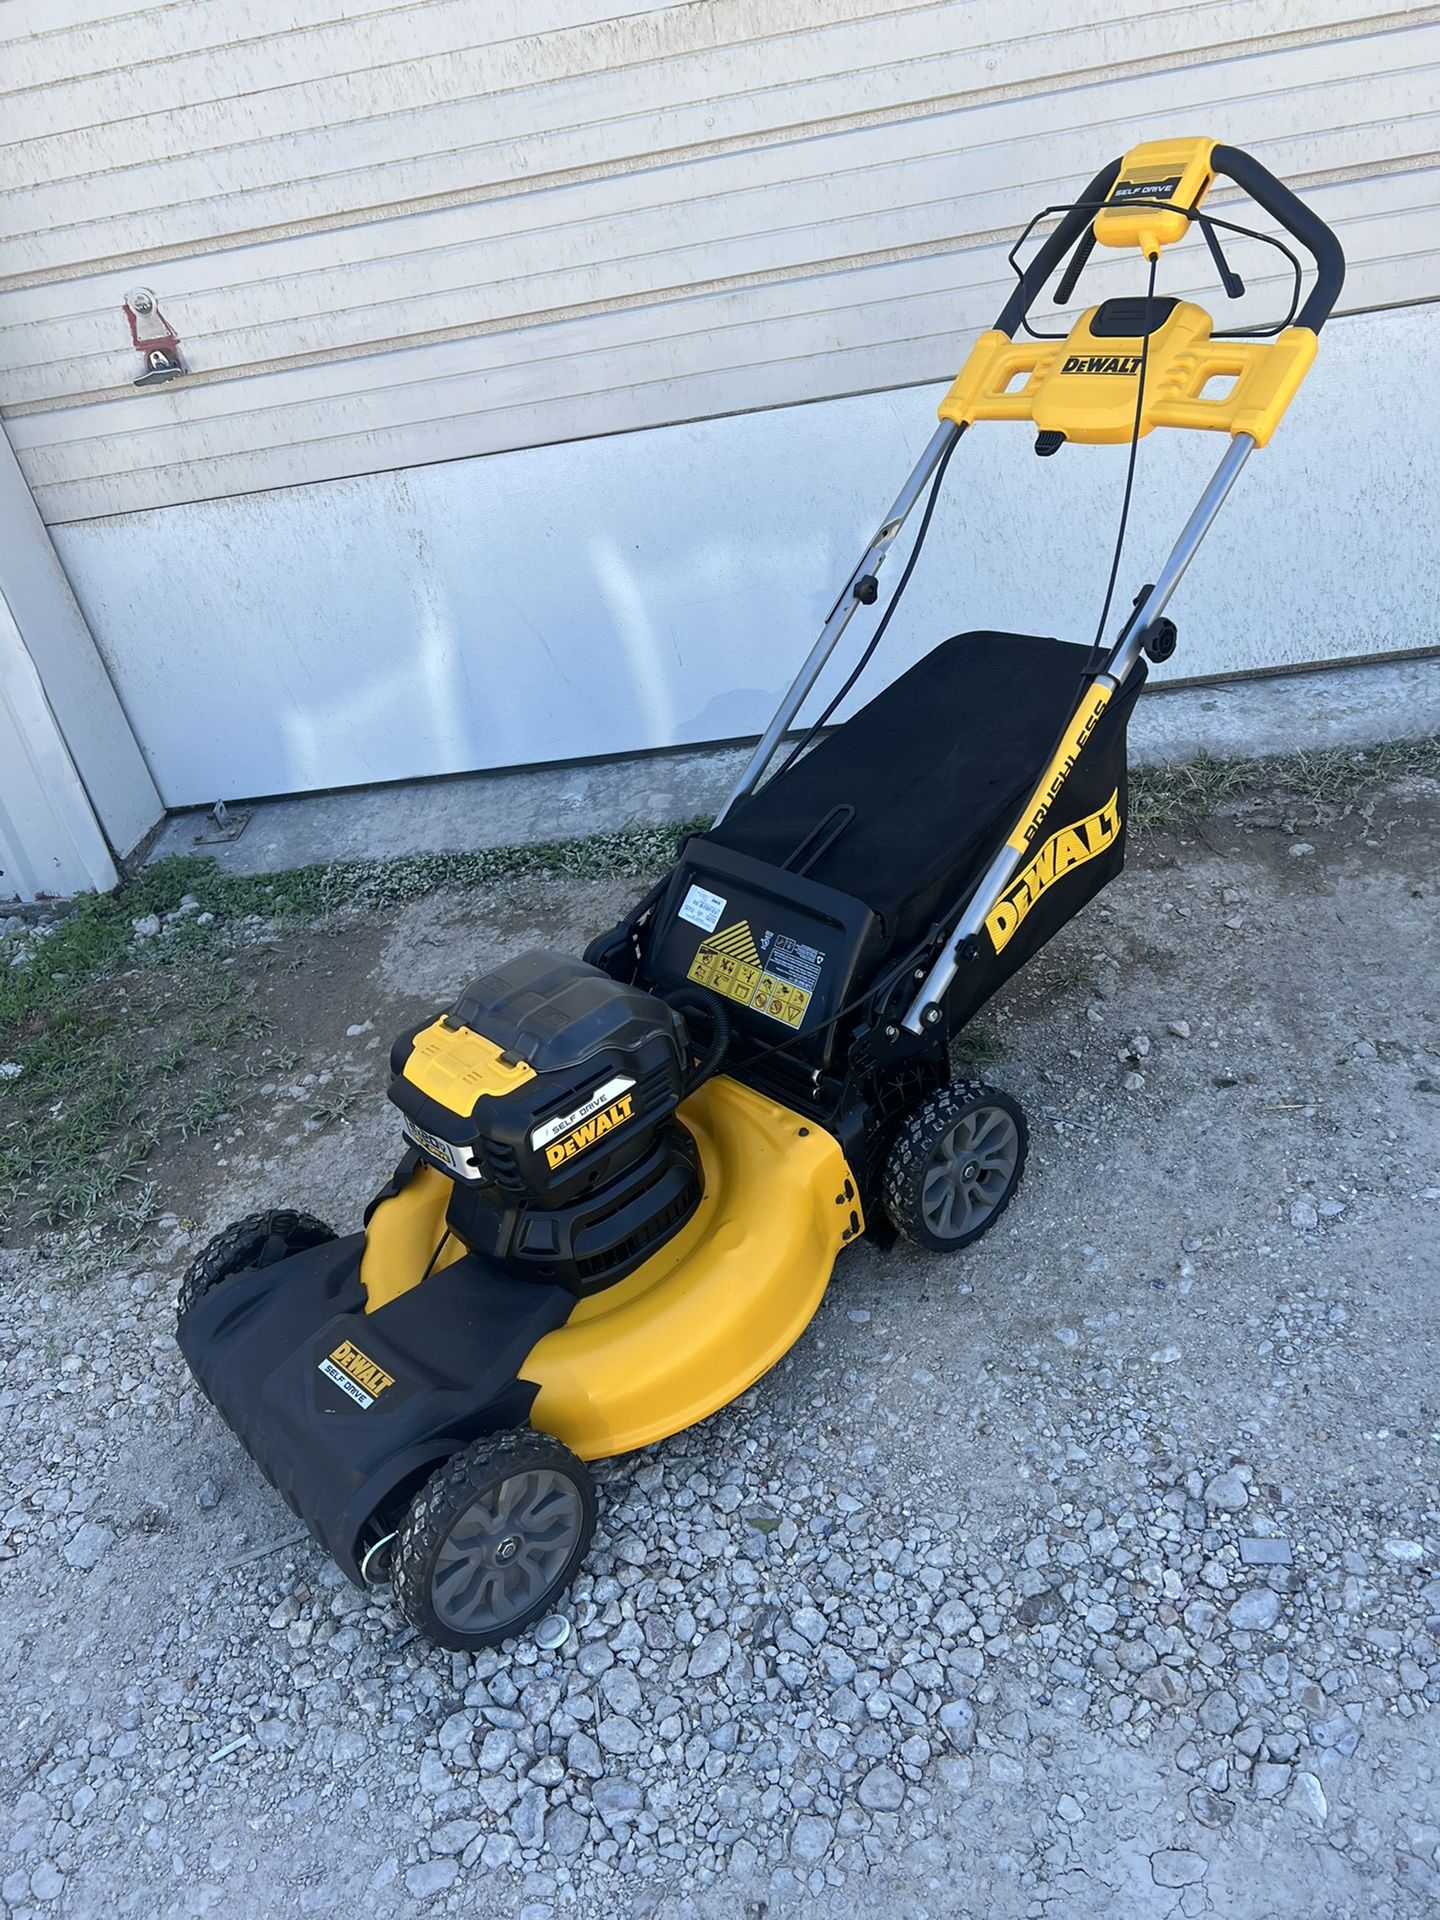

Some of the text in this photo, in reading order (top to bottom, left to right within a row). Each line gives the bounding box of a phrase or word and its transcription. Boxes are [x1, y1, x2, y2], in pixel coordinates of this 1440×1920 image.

[1115, 184, 1173, 197] SELF DRIVE
[545, 1095, 633, 1168] DEWALT
[552, 1094, 608, 1135] SELF DRIVE
[325, 1365, 368, 1403] SELF DRIVE
[330, 1341, 393, 1395] DEWALT
